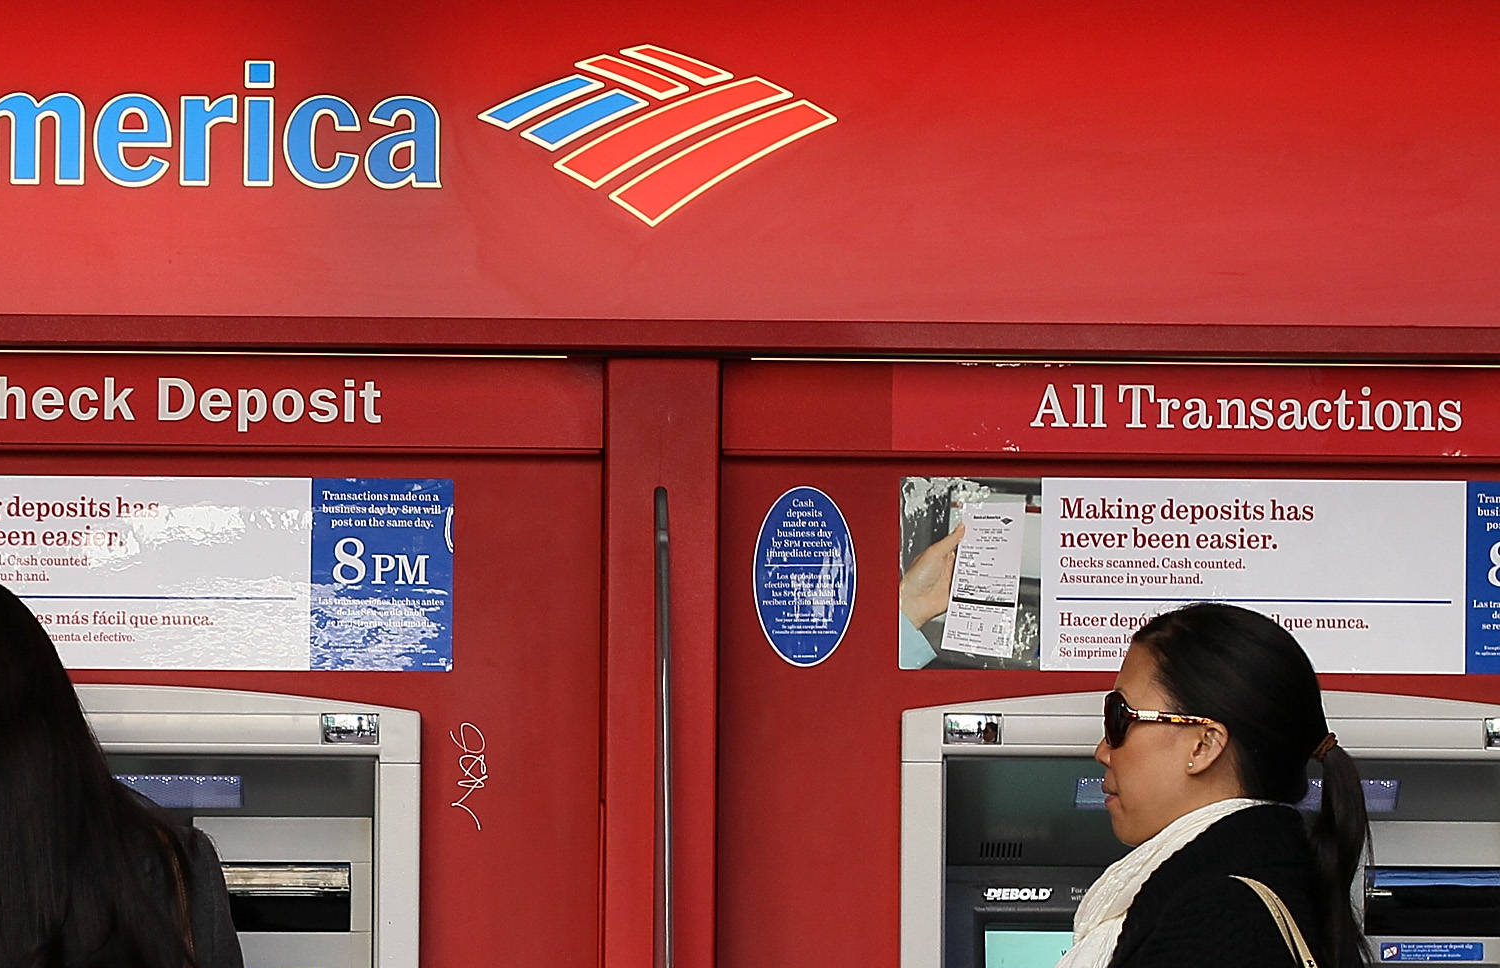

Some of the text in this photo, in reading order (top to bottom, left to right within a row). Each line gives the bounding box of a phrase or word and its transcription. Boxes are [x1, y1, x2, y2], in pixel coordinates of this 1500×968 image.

[158, 378, 381, 432] Deposit
[1030, 384, 1461, 431] All Transactions
[322, 491, 388, 501] Transactions
[390, 490, 417, 501] made
[7, 496, 110, 522] deposits
[116, 497, 159, 518] has
[793, 499, 814, 507] Cash
[322, 504, 441, 515] business day by 8PM will
[787, 509, 822, 519] deposits
[1060, 498, 1313, 524] Making deposits has
[332, 518, 353, 528] post
[369, 518, 385, 527] the
[414, 518, 433, 529] day.
[783, 519, 806, 527] made
[42, 525, 124, 547] easier.
[777, 529, 832, 539] business day
[1060, 527, 1277, 549] never been easier.
[772, 538, 782, 548] by
[803, 540, 832, 548] receive
[7, 555, 37, 567] Cash
[42, 555, 91, 567] counted.
[332, 537, 430, 585] 8 PM
[1060, 557, 1245, 569] Checks scanned. Cash counted.
[16, 571, 50, 582] hand.
[1060, 573, 1203, 586] Assurance in your hand.
[56, 611, 88, 625] más
[93, 611, 126, 625] fácil
[130, 614, 158, 628] que
[162, 615, 214, 626] nunca.
[1060, 612, 1107, 627] Hacer
[1284, 618, 1369, 631] que nunca.
[1060, 633, 1121, 644] Se escanean
[1060, 647, 1117, 659] Se imprime
[984, 888, 1052, 900] DIEBOLD
